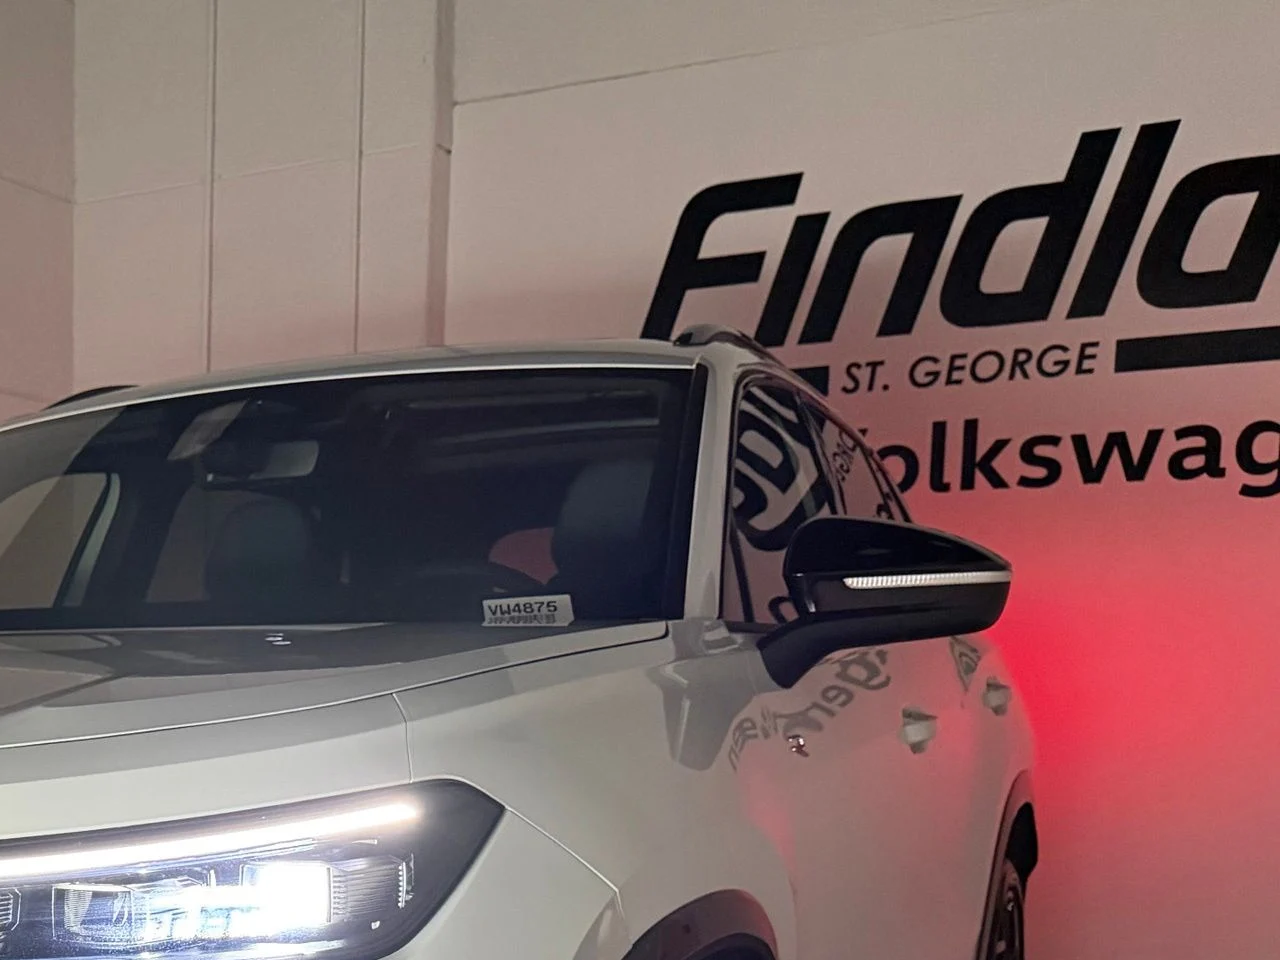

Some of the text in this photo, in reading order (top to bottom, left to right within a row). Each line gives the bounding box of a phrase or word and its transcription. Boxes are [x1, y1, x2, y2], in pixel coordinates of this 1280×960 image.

[841, 341, 1100, 395] ST. GEORGE
[858, 417, 1280, 499] olkswag
[487, 600, 558, 617] VW4875
